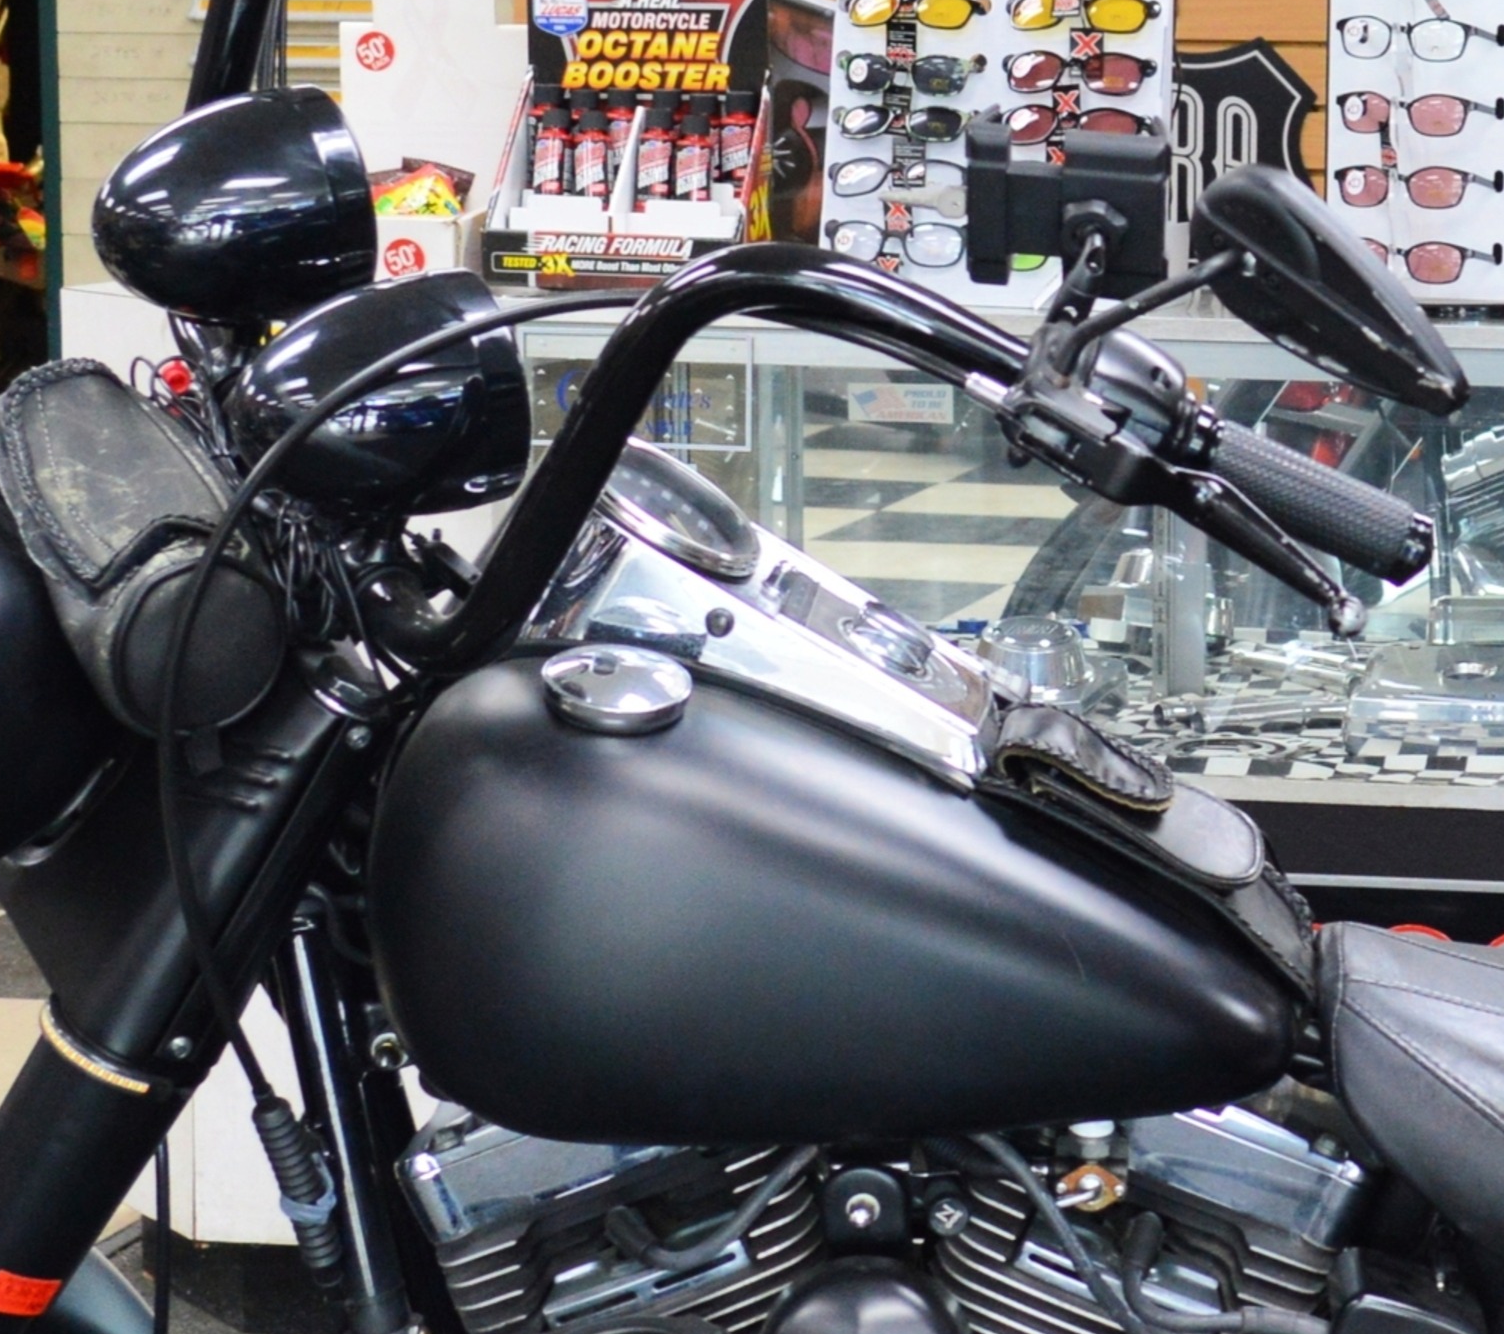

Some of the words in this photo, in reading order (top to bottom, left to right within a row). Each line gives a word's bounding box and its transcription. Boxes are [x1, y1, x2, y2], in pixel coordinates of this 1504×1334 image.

[540, 4, 582, 16] LUCAS
[590, 12, 711, 30] MOTORCYCLE
[576, 30, 724, 61] OCTANE
[561, 60, 731, 91] BOOSTER
[538, 235, 608, 254] RACING
[608, 237, 694, 259] FORMULA
[502, 256, 538, 268] TESTED
[540, 252, 576, 278] 3X
